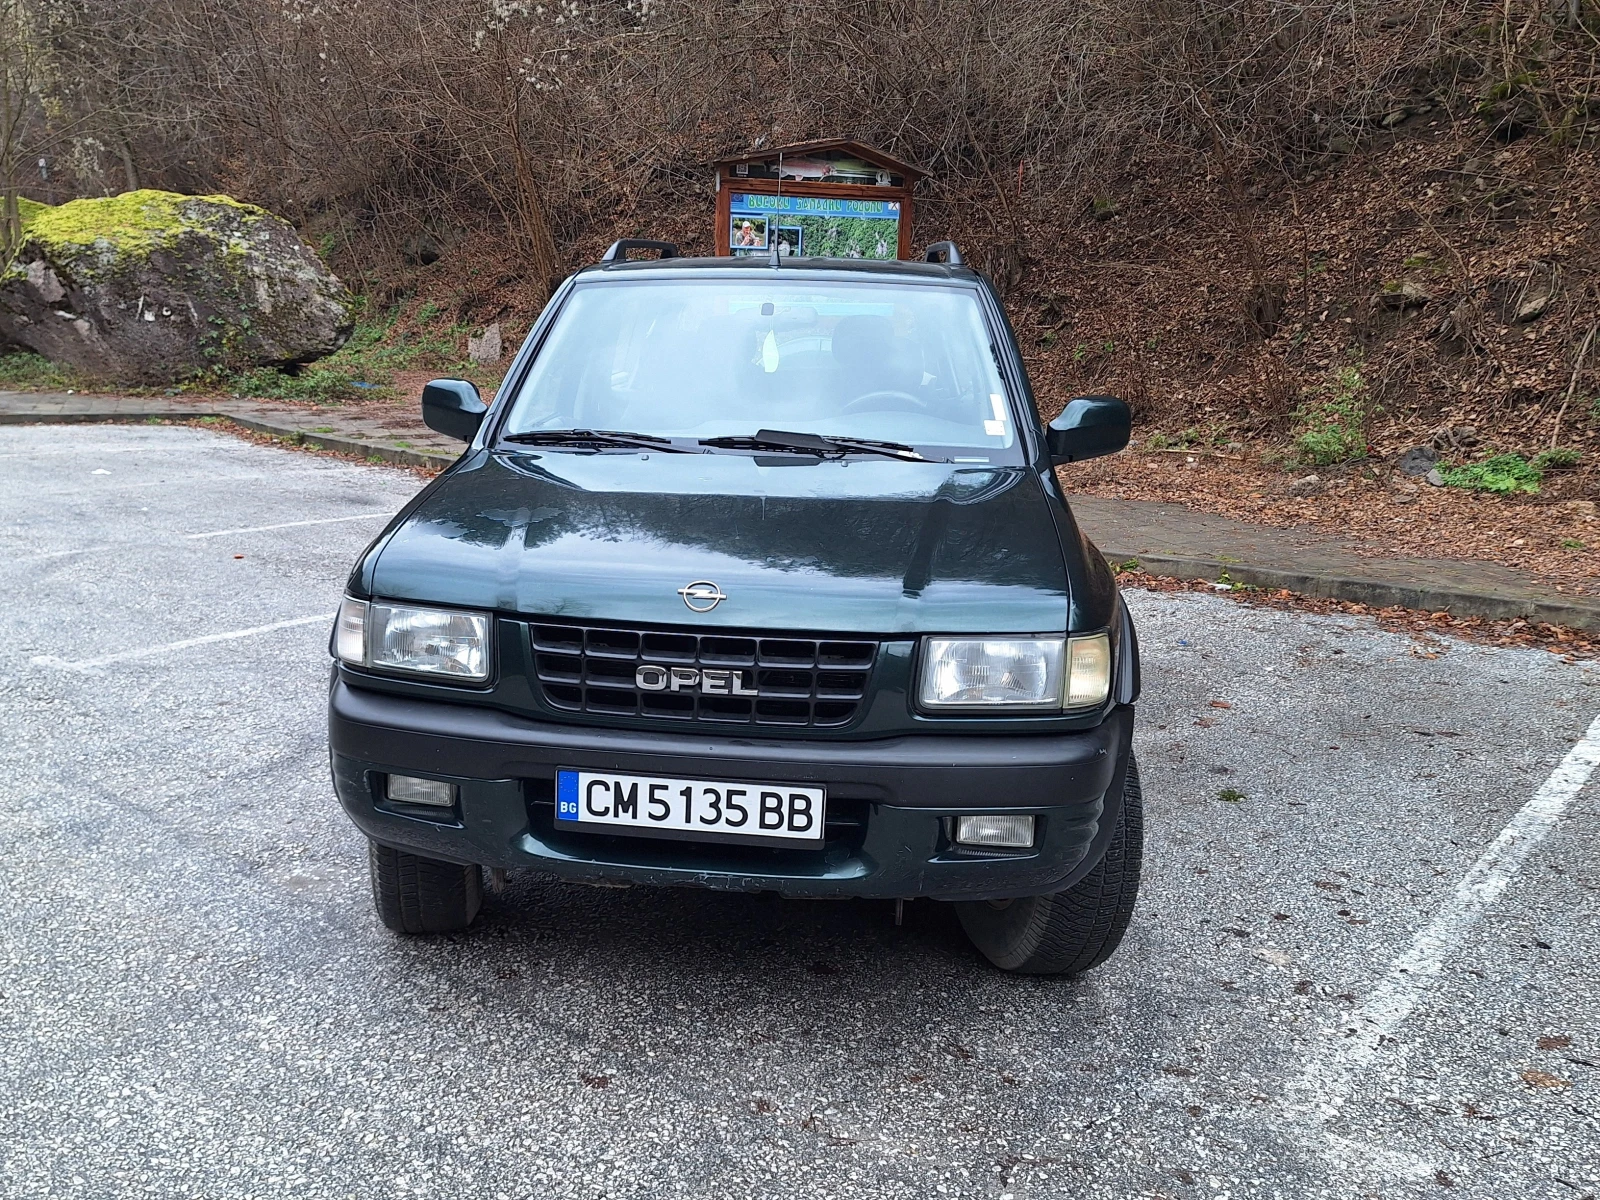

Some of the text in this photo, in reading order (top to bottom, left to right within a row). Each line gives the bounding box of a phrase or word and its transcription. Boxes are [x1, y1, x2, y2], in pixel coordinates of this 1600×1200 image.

[636, 665, 758, 695] OPEL
[560, 802, 577, 814] BG
[648, 784, 748, 827] 5135
